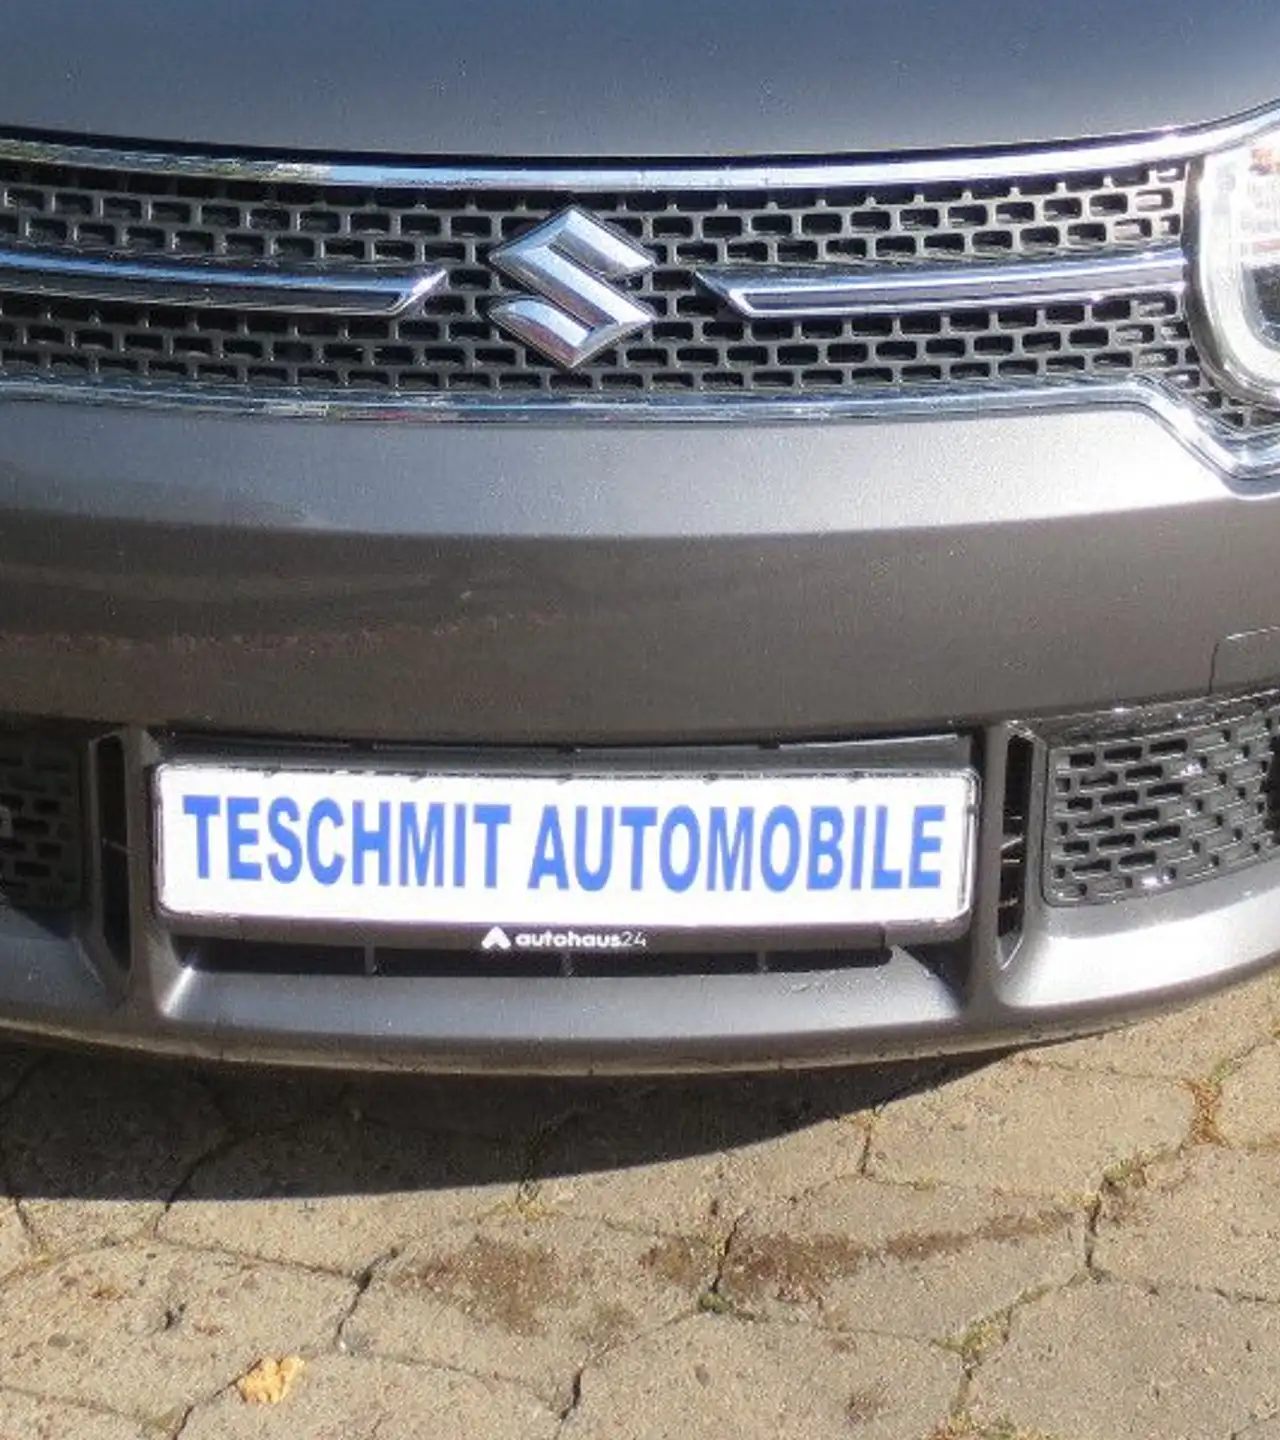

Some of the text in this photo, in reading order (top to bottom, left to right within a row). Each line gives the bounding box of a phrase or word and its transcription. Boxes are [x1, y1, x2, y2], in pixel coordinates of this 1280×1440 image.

[182, 793, 946, 894] TESCHMIT AUTOMOBILE
[515, 930, 647, 948] autohaus24
